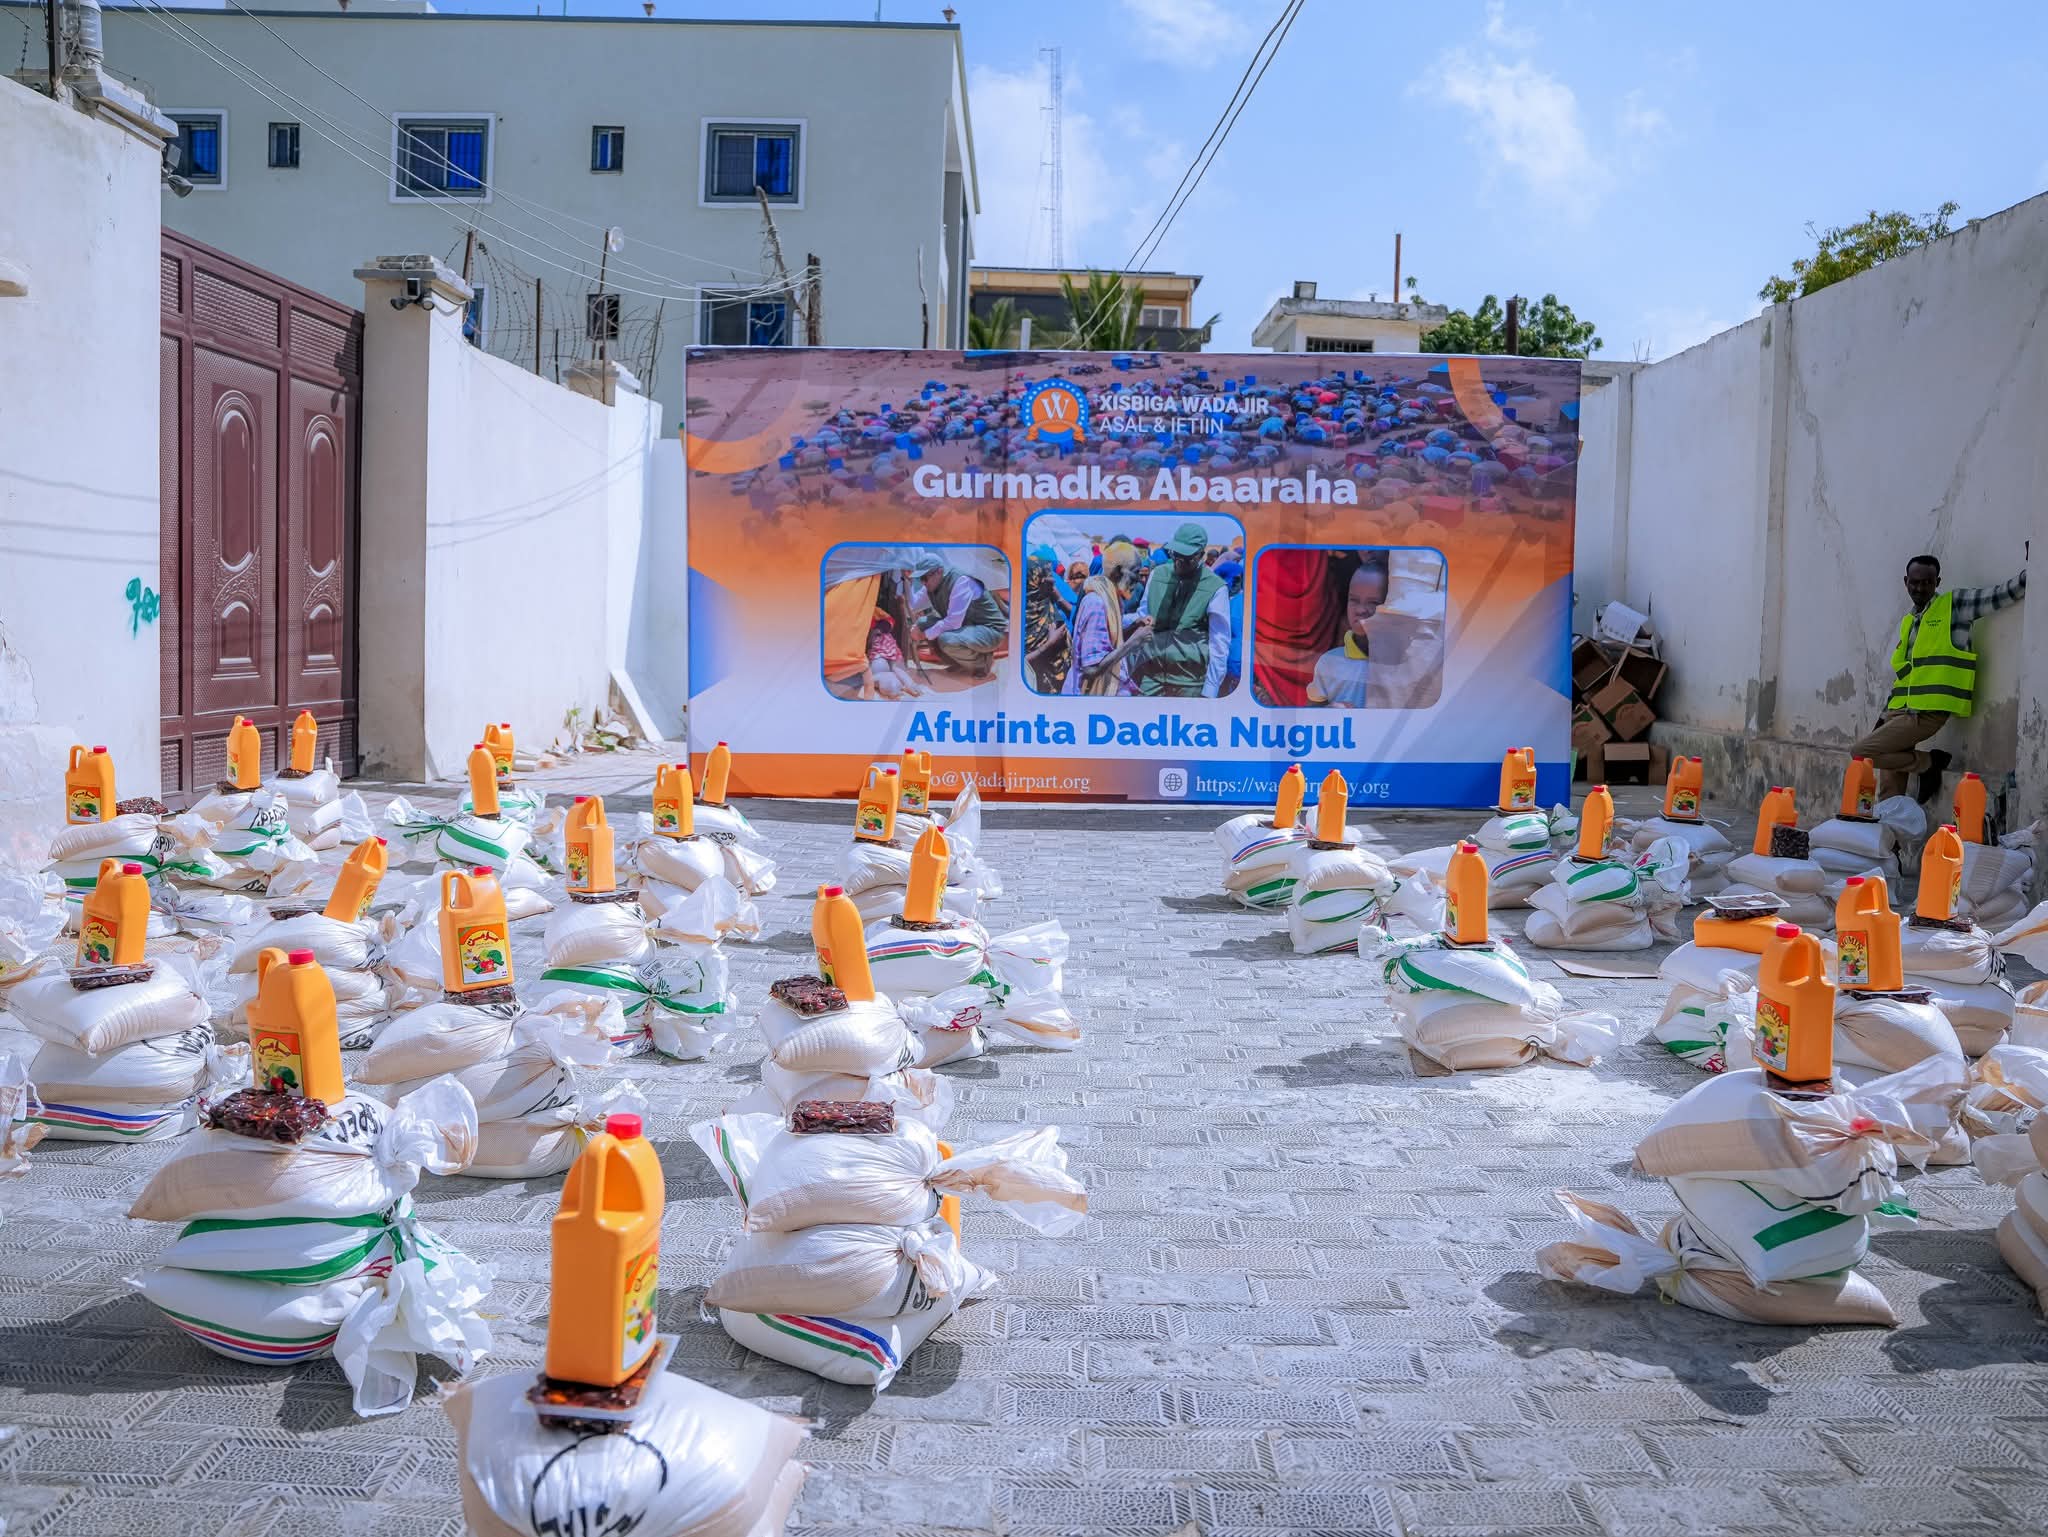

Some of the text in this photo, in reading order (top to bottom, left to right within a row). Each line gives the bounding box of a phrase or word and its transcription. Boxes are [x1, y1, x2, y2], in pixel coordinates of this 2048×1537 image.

[1100, 395, 1269, 415] XISBIGA WADAJIR
[1100, 416, 1149, 433] ASAL
[1153, 417, 1165, 433] &
[912, 464, 1358, 505] Gurmadka Abaaraha
[906, 711, 1356, 756] Afurinta Dadka Nugul
[930, 771, 1090, 792] o@Wadajirpart.org
